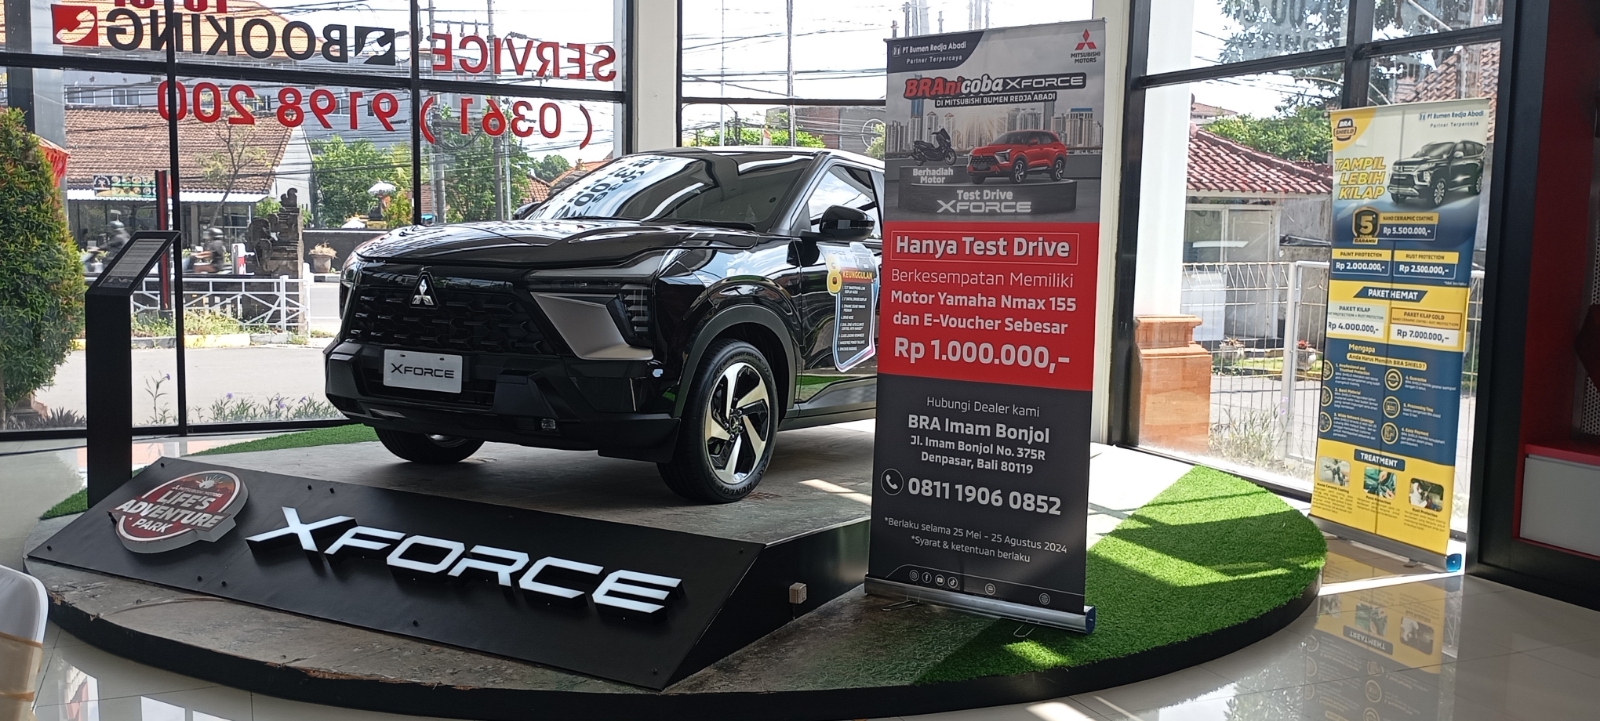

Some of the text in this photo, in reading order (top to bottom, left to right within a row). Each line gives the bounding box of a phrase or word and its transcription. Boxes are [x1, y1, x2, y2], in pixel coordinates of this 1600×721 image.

[902, 41, 966, 54] PT Bumen Redja Abadi
[929, 55, 962, 64] Terpercaya
[945, 97, 982, 106] MITSUBISHI
[983, 96, 1008, 104] BUMEN
[1009, 94, 1032, 103] REDJA
[1033, 93, 1056, 101] ABADI
[1334, 157, 1386, 171] TAMPIL
[913, 168, 954, 177] Berhadiah
[920, 175, 945, 183] Motor
[1339, 172, 1384, 185] LEBIH
[957, 190, 1013, 200] Test Drive
[1339, 186, 1385, 200] KILAP
[936, 200, 1032, 213] XFORCE
[1360, 215, 1374, 234] 5
[1383, 227, 1392, 235] Rp
[896, 236, 1070, 258] Hanya Test Drive
[1336, 262, 1344, 270] Rp
[1399, 265, 1409, 273] Rp
[892, 269, 1074, 288] Berkesempatan Memiliki
[891, 290, 1077, 312] Motor Yamaha Nmax 155
[1368, 289, 1418, 300] PAKET HEMAT
[893, 312, 1068, 334] dan E-Voucher Sebesar
[1397, 329, 1407, 339] Rp
[895, 337, 1070, 374] Rp 1.000.000,-
[1349, 344, 1376, 353] Mengapa
[390, 363, 454, 378] XFORCE
[927, 397, 1040, 417] Hubungi Dealer kami
[908, 414, 1050, 445] BRA Imam Bonjol
[910, 435, 1046, 461] Jl. Imam Bonjol No. 375R
[921, 451, 1034, 474] Denpasar, Bali 80119
[1360, 452, 1398, 467] TREATMENT
[157, 490, 216, 510] LIFE'S
[908, 478, 1061, 515] 0811 1906 0852
[114, 499, 224, 528] ADVENTURE
[131, 518, 173, 533] PARK
[921, 523, 950, 534] selama
[953, 528, 964, 537] 25
[966, 529, 982, 539] Mei
[991, 533, 1002, 543] 25
[1004, 536, 1042, 549] Agustus
[1044, 542, 1067, 553] 2024
[951, 542, 995, 557] ketentuan
[998, 549, 1030, 562] berlaku
[245, 506, 683, 615] XFORCE
